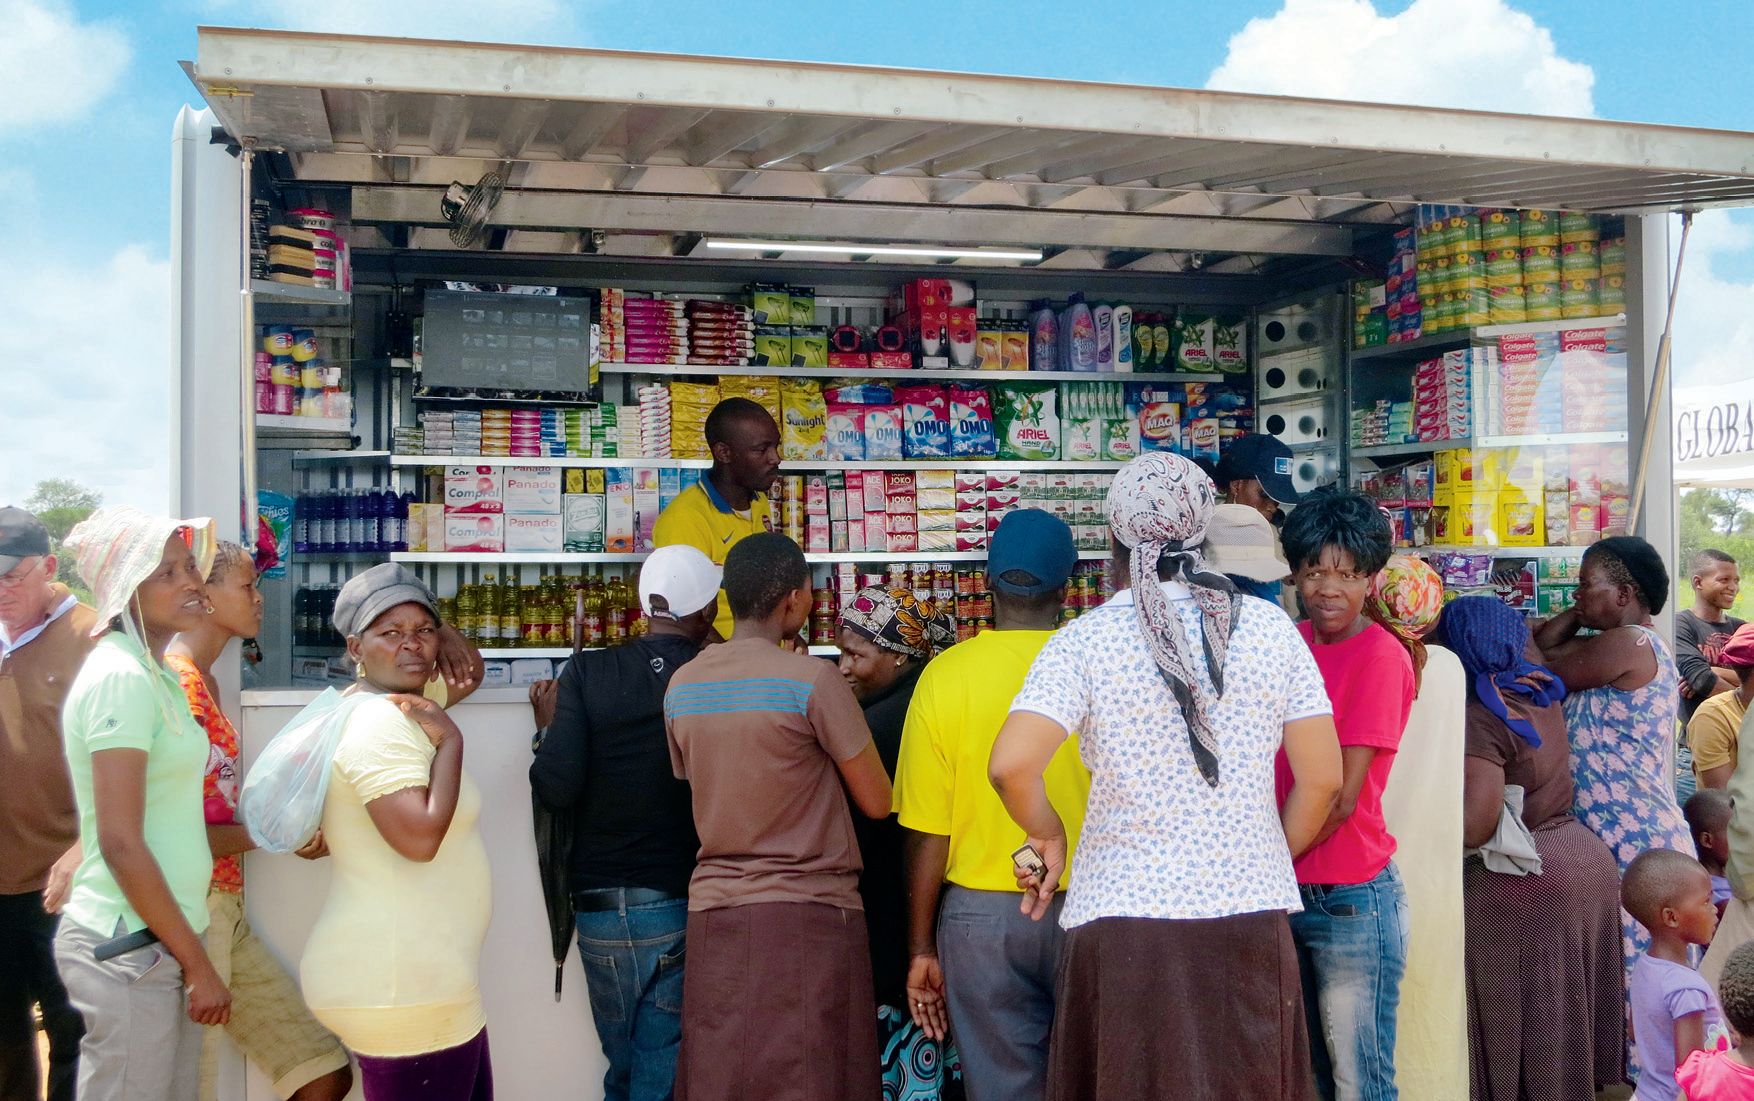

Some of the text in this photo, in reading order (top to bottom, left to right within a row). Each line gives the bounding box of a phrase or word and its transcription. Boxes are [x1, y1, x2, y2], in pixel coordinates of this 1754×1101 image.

[1565, 330, 1605, 339] Colgate
[1503, 342, 1535, 351] Colgate
[1185, 349, 1208, 357] ARIEL
[1219, 351, 1241, 359] ARIEL
[1505, 352, 1536, 361] Colgate
[786, 414, 825, 428] Sunlight
[1147, 416, 1173, 430] MAQ
[914, 420, 947, 436] OMO
[960, 419, 990, 435] OMO
[838, 431, 860, 443] OMO
[876, 428, 901, 441] OMO
[1017, 429, 1049, 440] ARIEL
[1195, 427, 1216, 439] MAQ
[508, 480, 556, 489] Panado
[890, 477, 911, 485] JOKO
[608, 484, 631, 492] ENO
[448, 487, 500, 500] Compral
[891, 496, 912, 504] JOKO
[509, 519, 557, 528] Panado
[892, 515, 913, 523] JOKO
[448, 527, 500, 539] Compral
